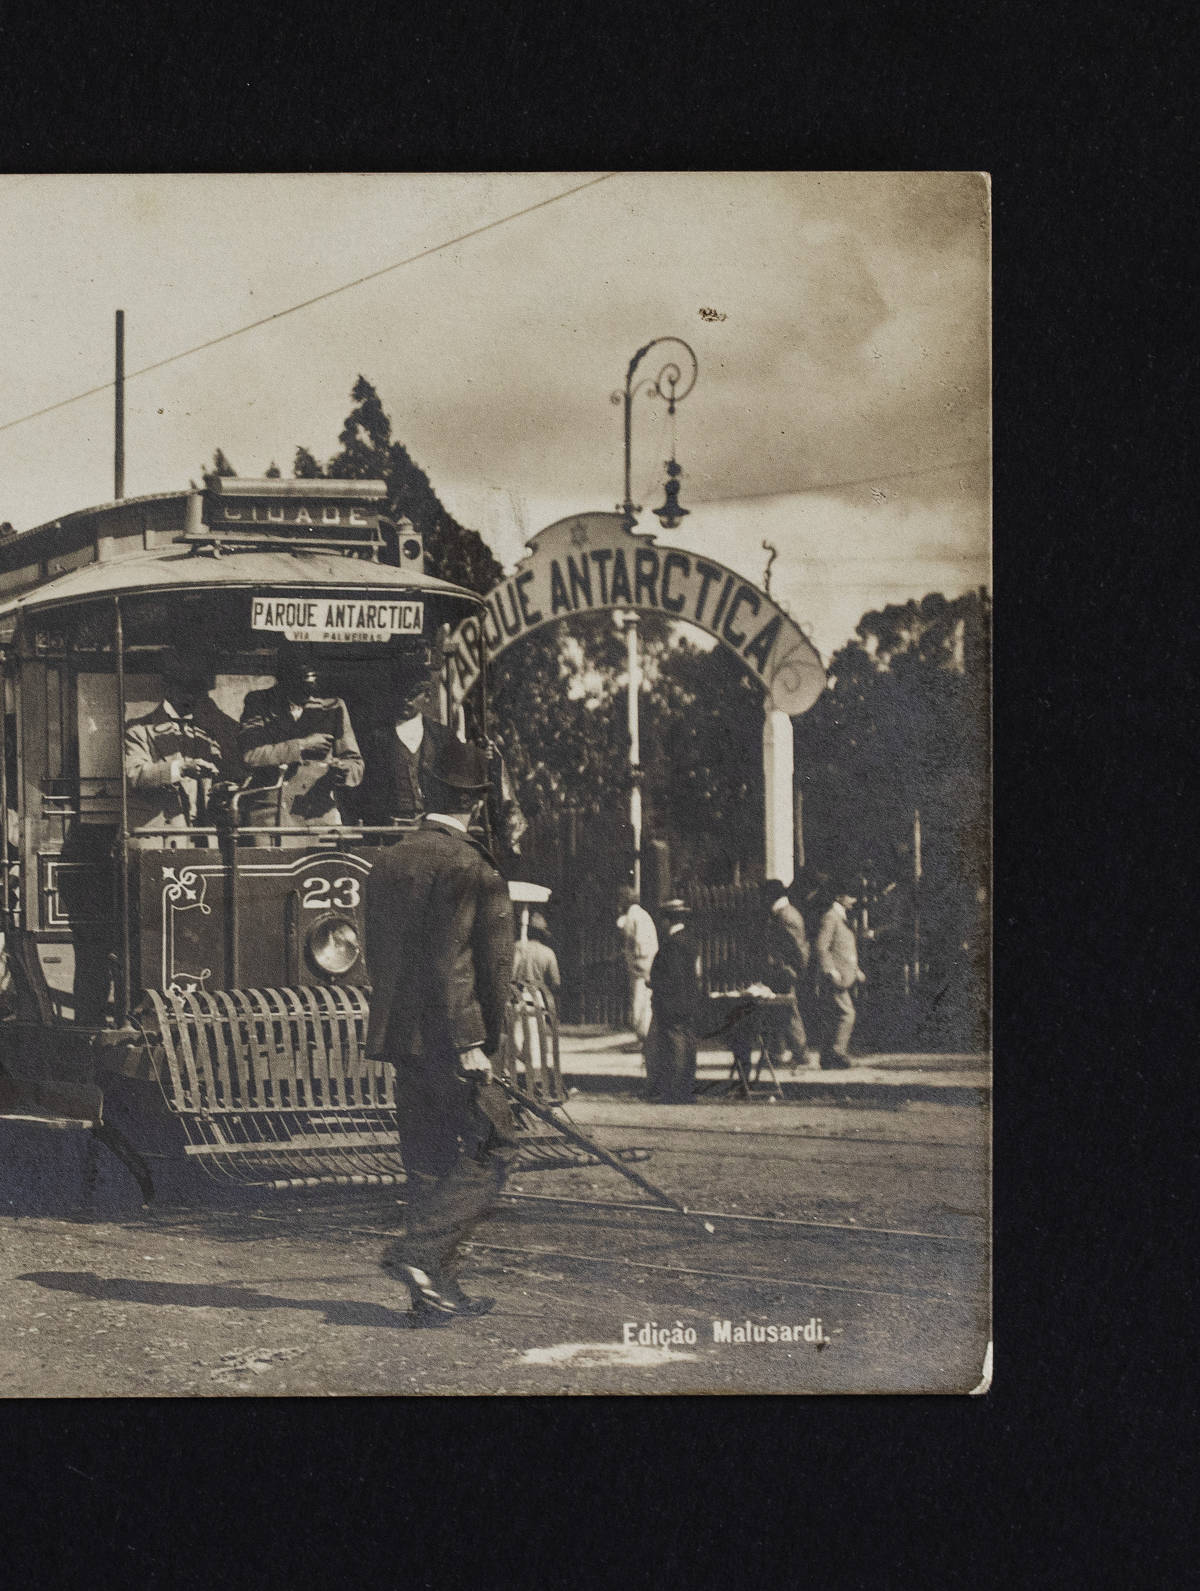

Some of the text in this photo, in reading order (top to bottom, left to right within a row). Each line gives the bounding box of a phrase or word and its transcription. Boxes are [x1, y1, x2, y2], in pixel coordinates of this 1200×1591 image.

[253, 602, 422, 629] PARQUE ANTARCTICA
[453, 547, 784, 691] ARQUE ANTARCTICA
[293, 631, 383, 641] VIA PALMEIRAS
[302, 877, 361, 909] 23
